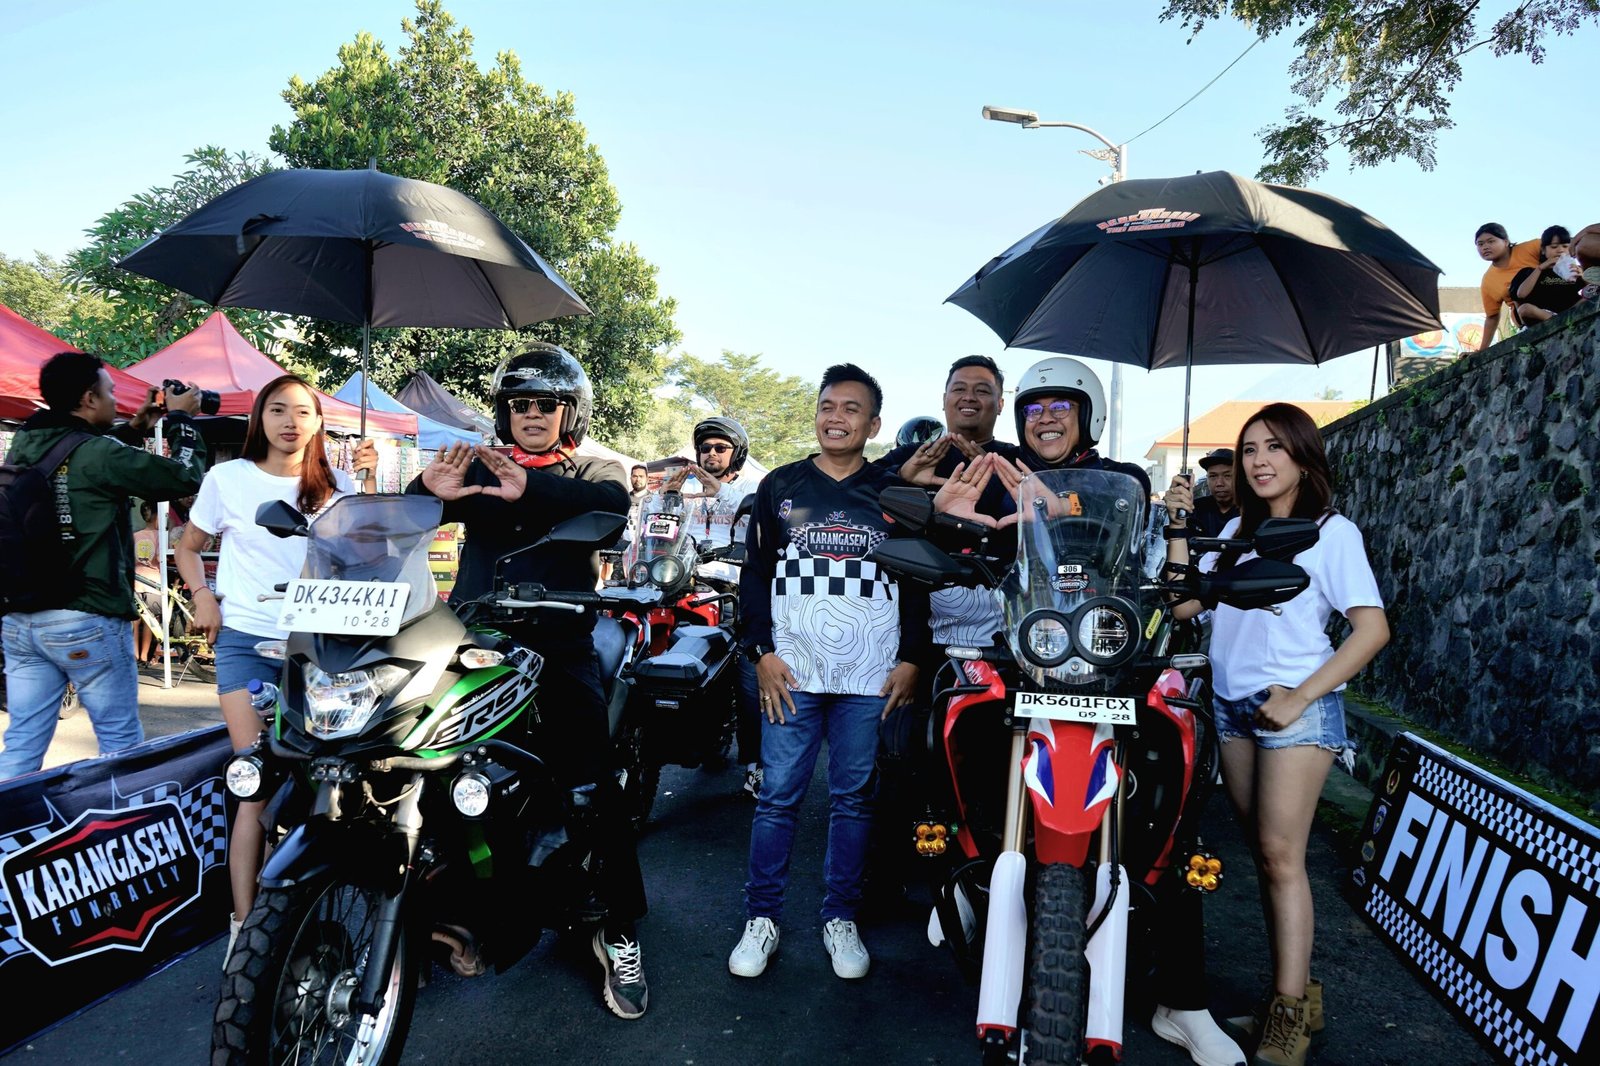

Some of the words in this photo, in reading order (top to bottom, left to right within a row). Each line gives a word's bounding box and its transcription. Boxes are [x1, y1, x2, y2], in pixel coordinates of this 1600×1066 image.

[810, 531, 867, 547] KARANGASEM
[294, 585, 398, 607] DK4344KAI
[1021, 693, 1130, 710] DK5601FCX
[15, 817, 187, 920] KARANGASEM
[1379, 790, 1600, 1054] FINISH
